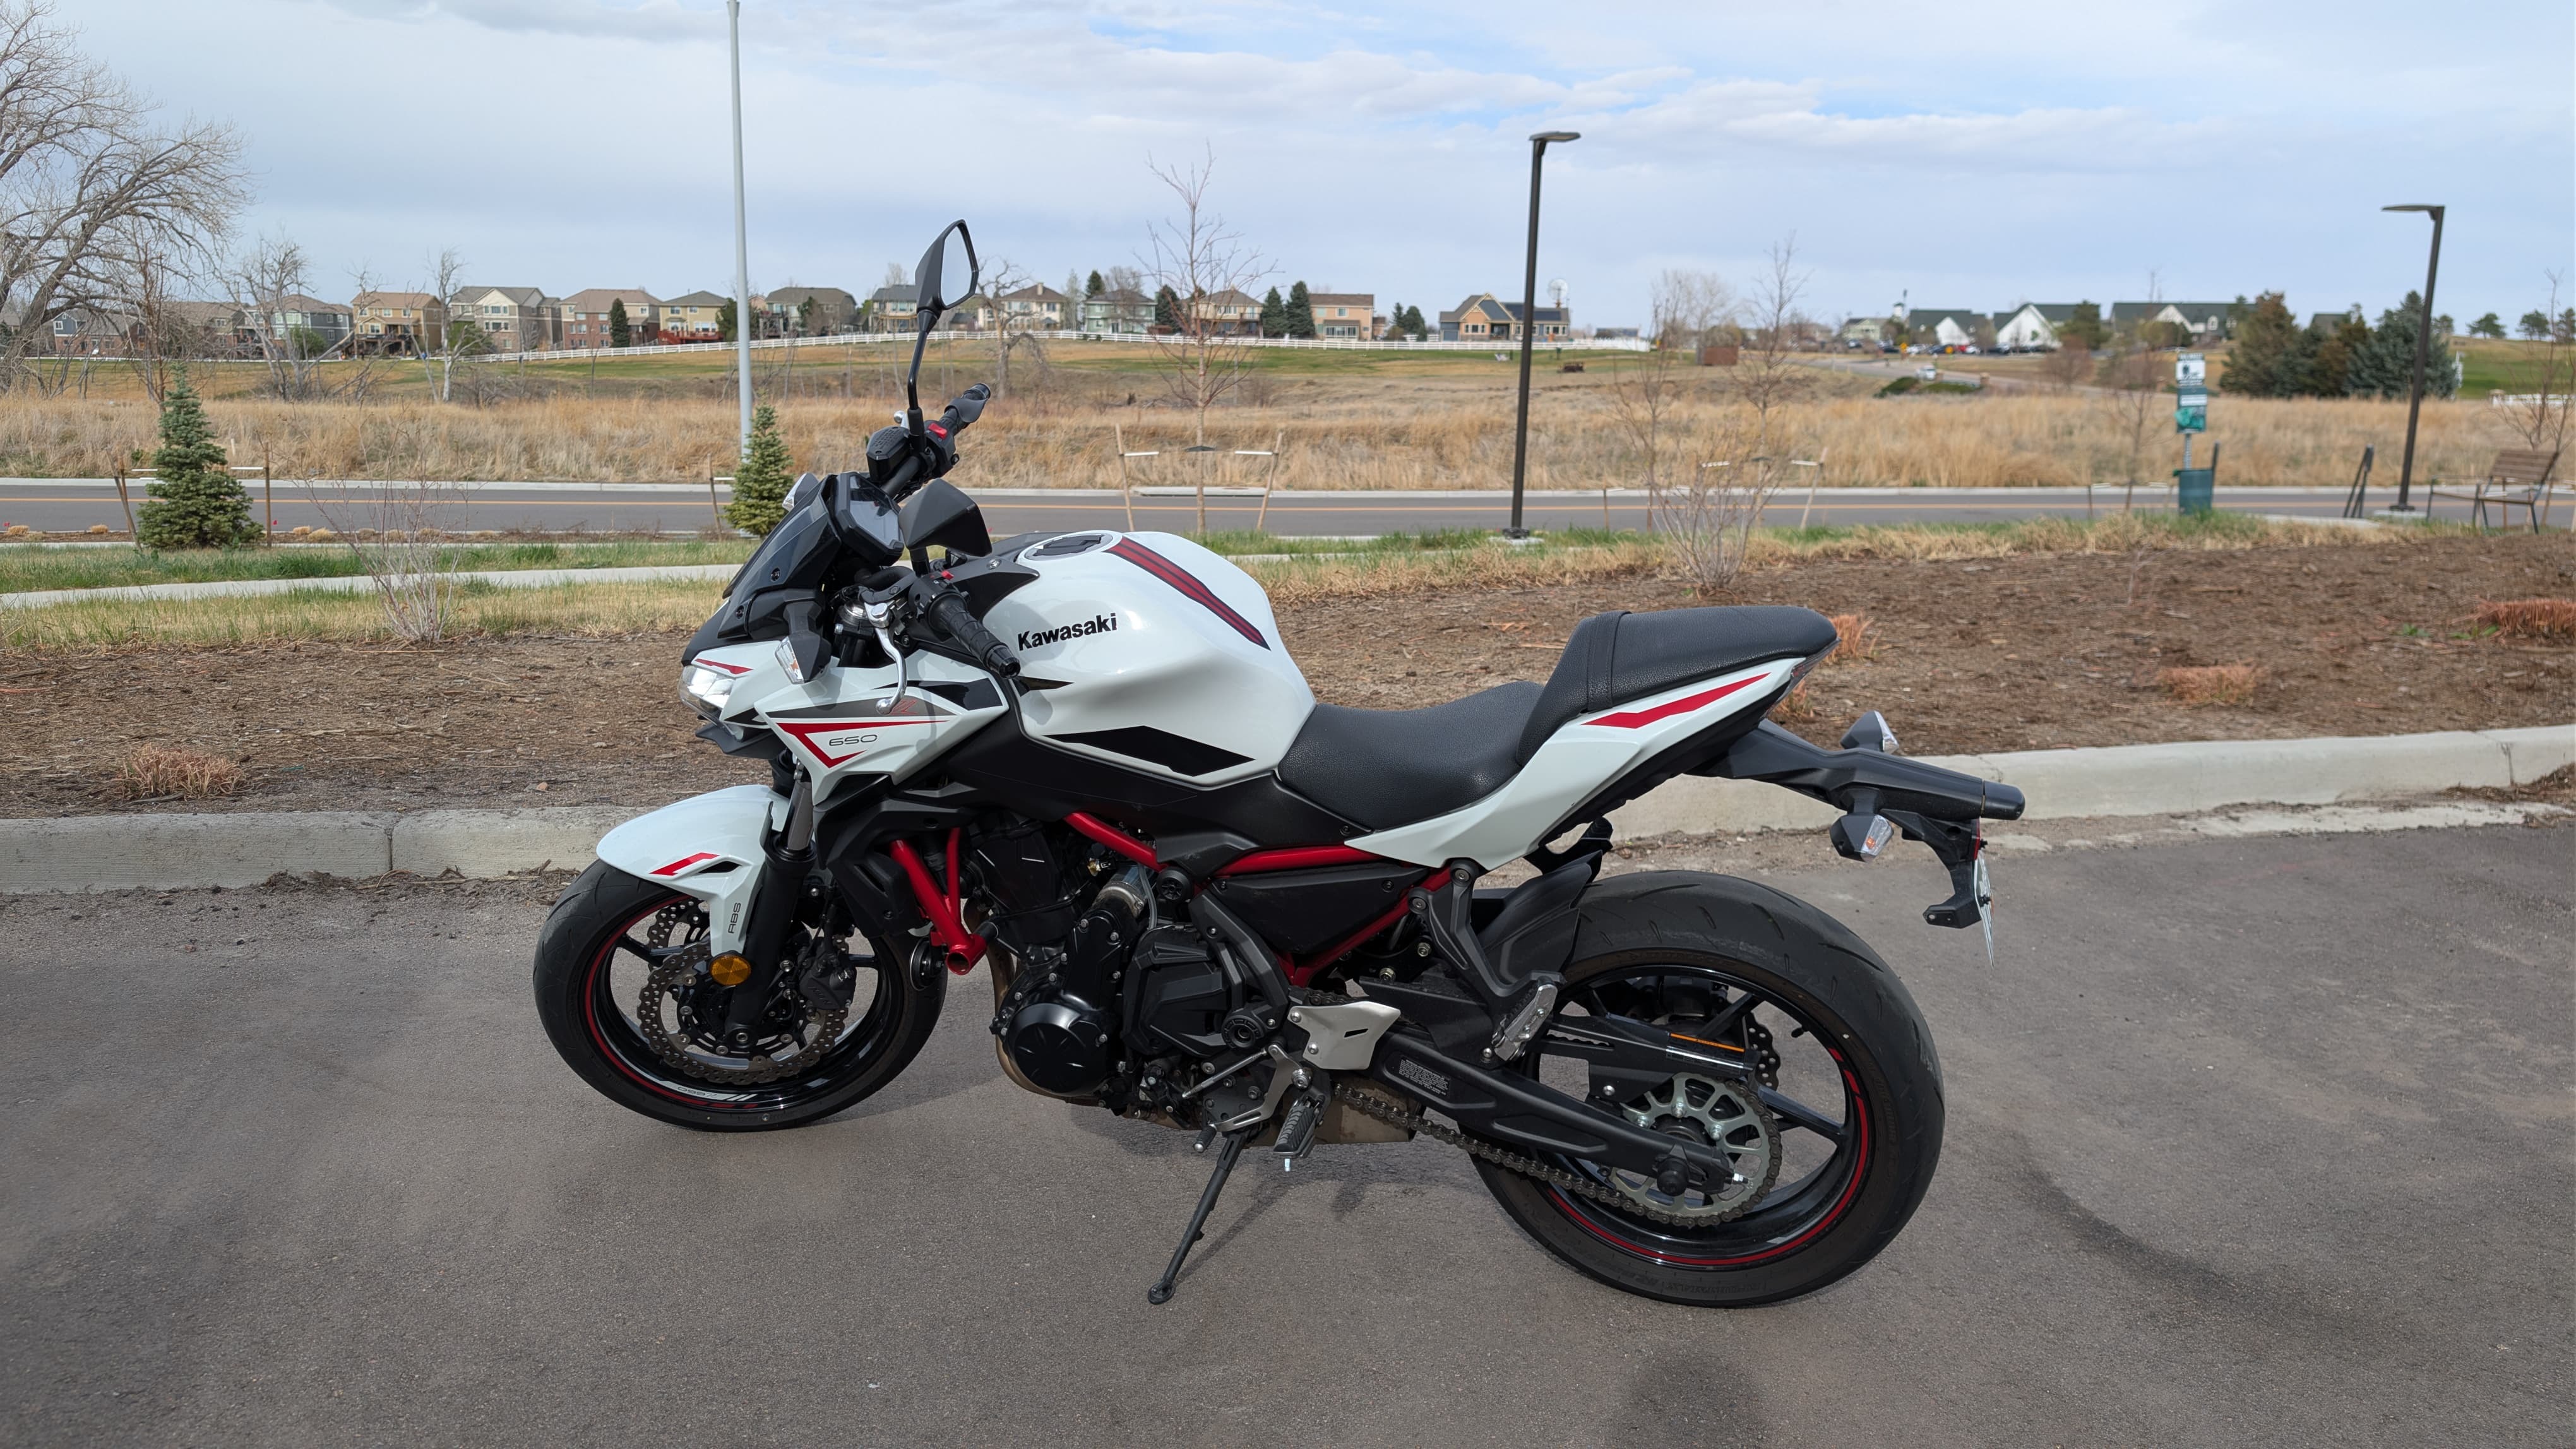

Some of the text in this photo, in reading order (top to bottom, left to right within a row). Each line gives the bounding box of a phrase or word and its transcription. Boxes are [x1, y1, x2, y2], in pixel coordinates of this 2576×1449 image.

[1017, 612, 1118, 652] Kawasaki
[829, 734, 878, 746] 650
[727, 902, 741, 934] ABS
